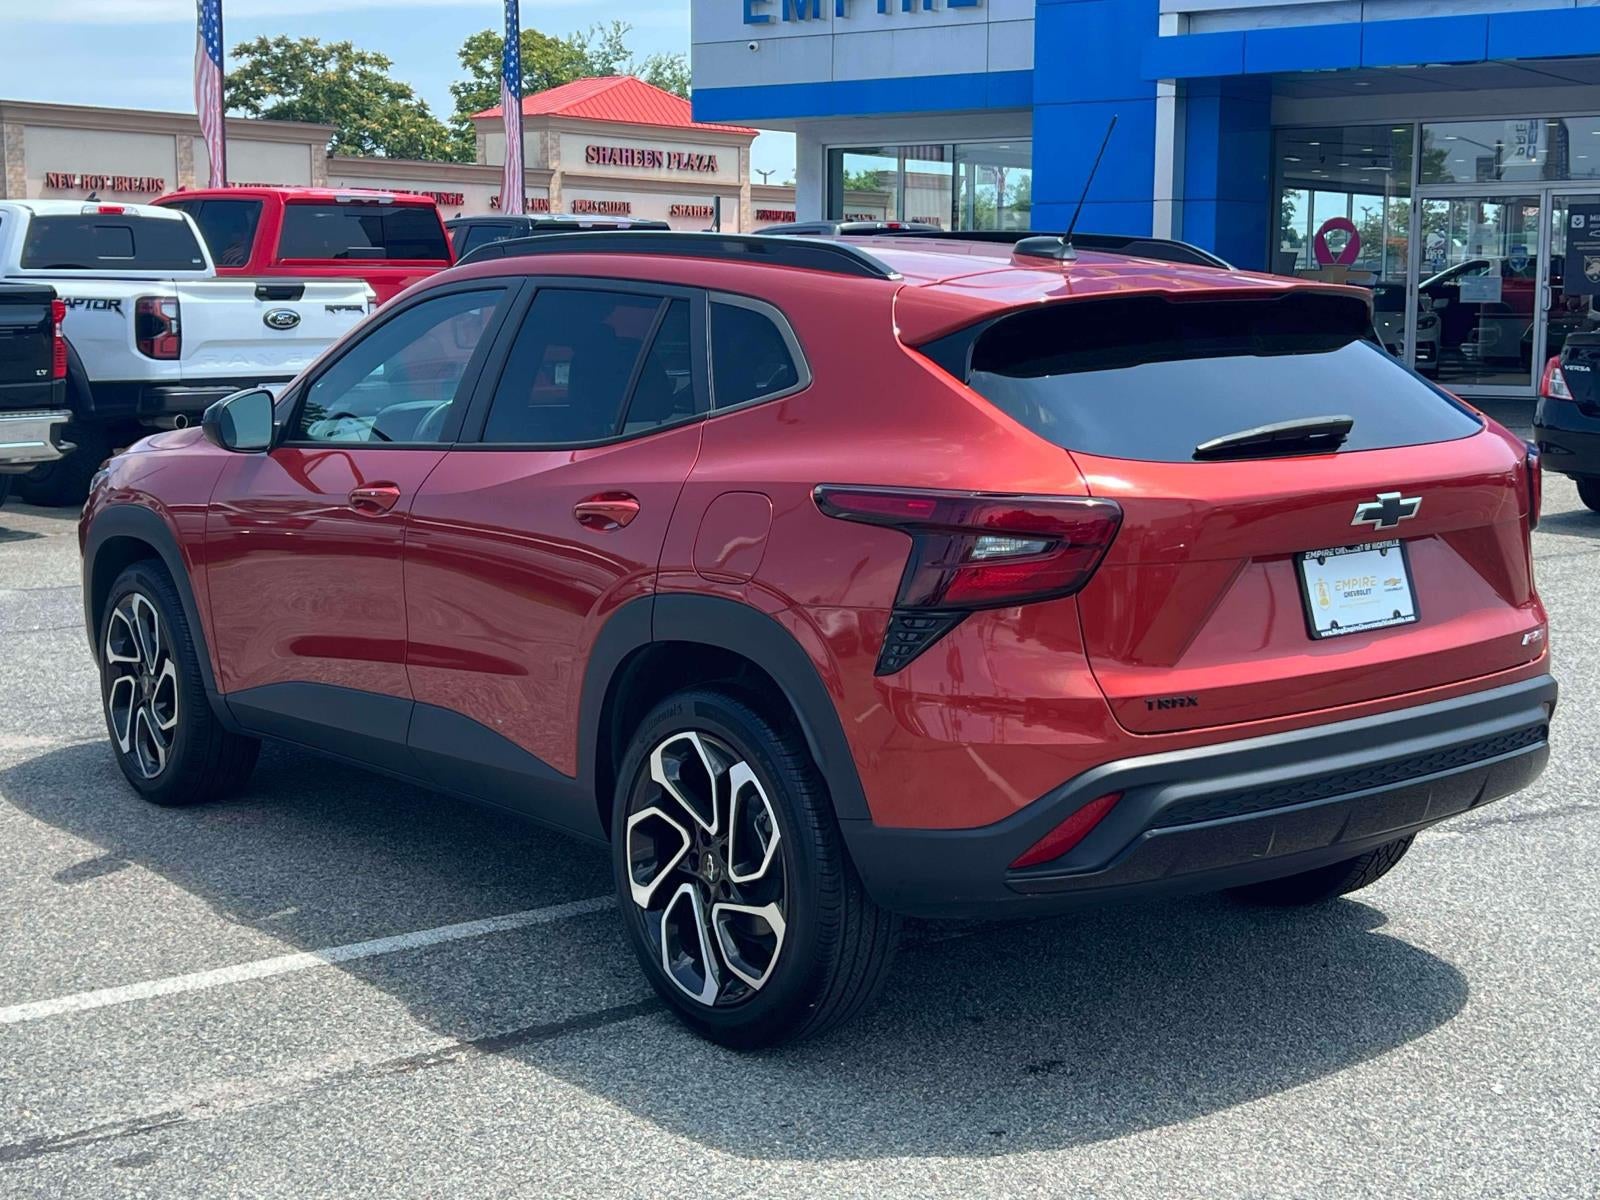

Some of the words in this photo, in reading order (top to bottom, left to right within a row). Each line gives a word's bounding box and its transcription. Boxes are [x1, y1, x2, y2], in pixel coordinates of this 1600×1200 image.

[586, 144, 664, 168] SHAHEEN
[667, 151, 718, 173] PLAZA
[46, 172, 76, 189] NEW
[80, 174, 109, 191] HOT
[112, 176, 166, 193] BREADS
[670, 204, 714, 217] SHAHEE
[63, 298, 126, 320] APTOR
[1564, 364, 1591, 372] VERSA
[1305, 548, 1335, 560] EMPIRE
[1334, 575, 1377, 592] EMPIRE
